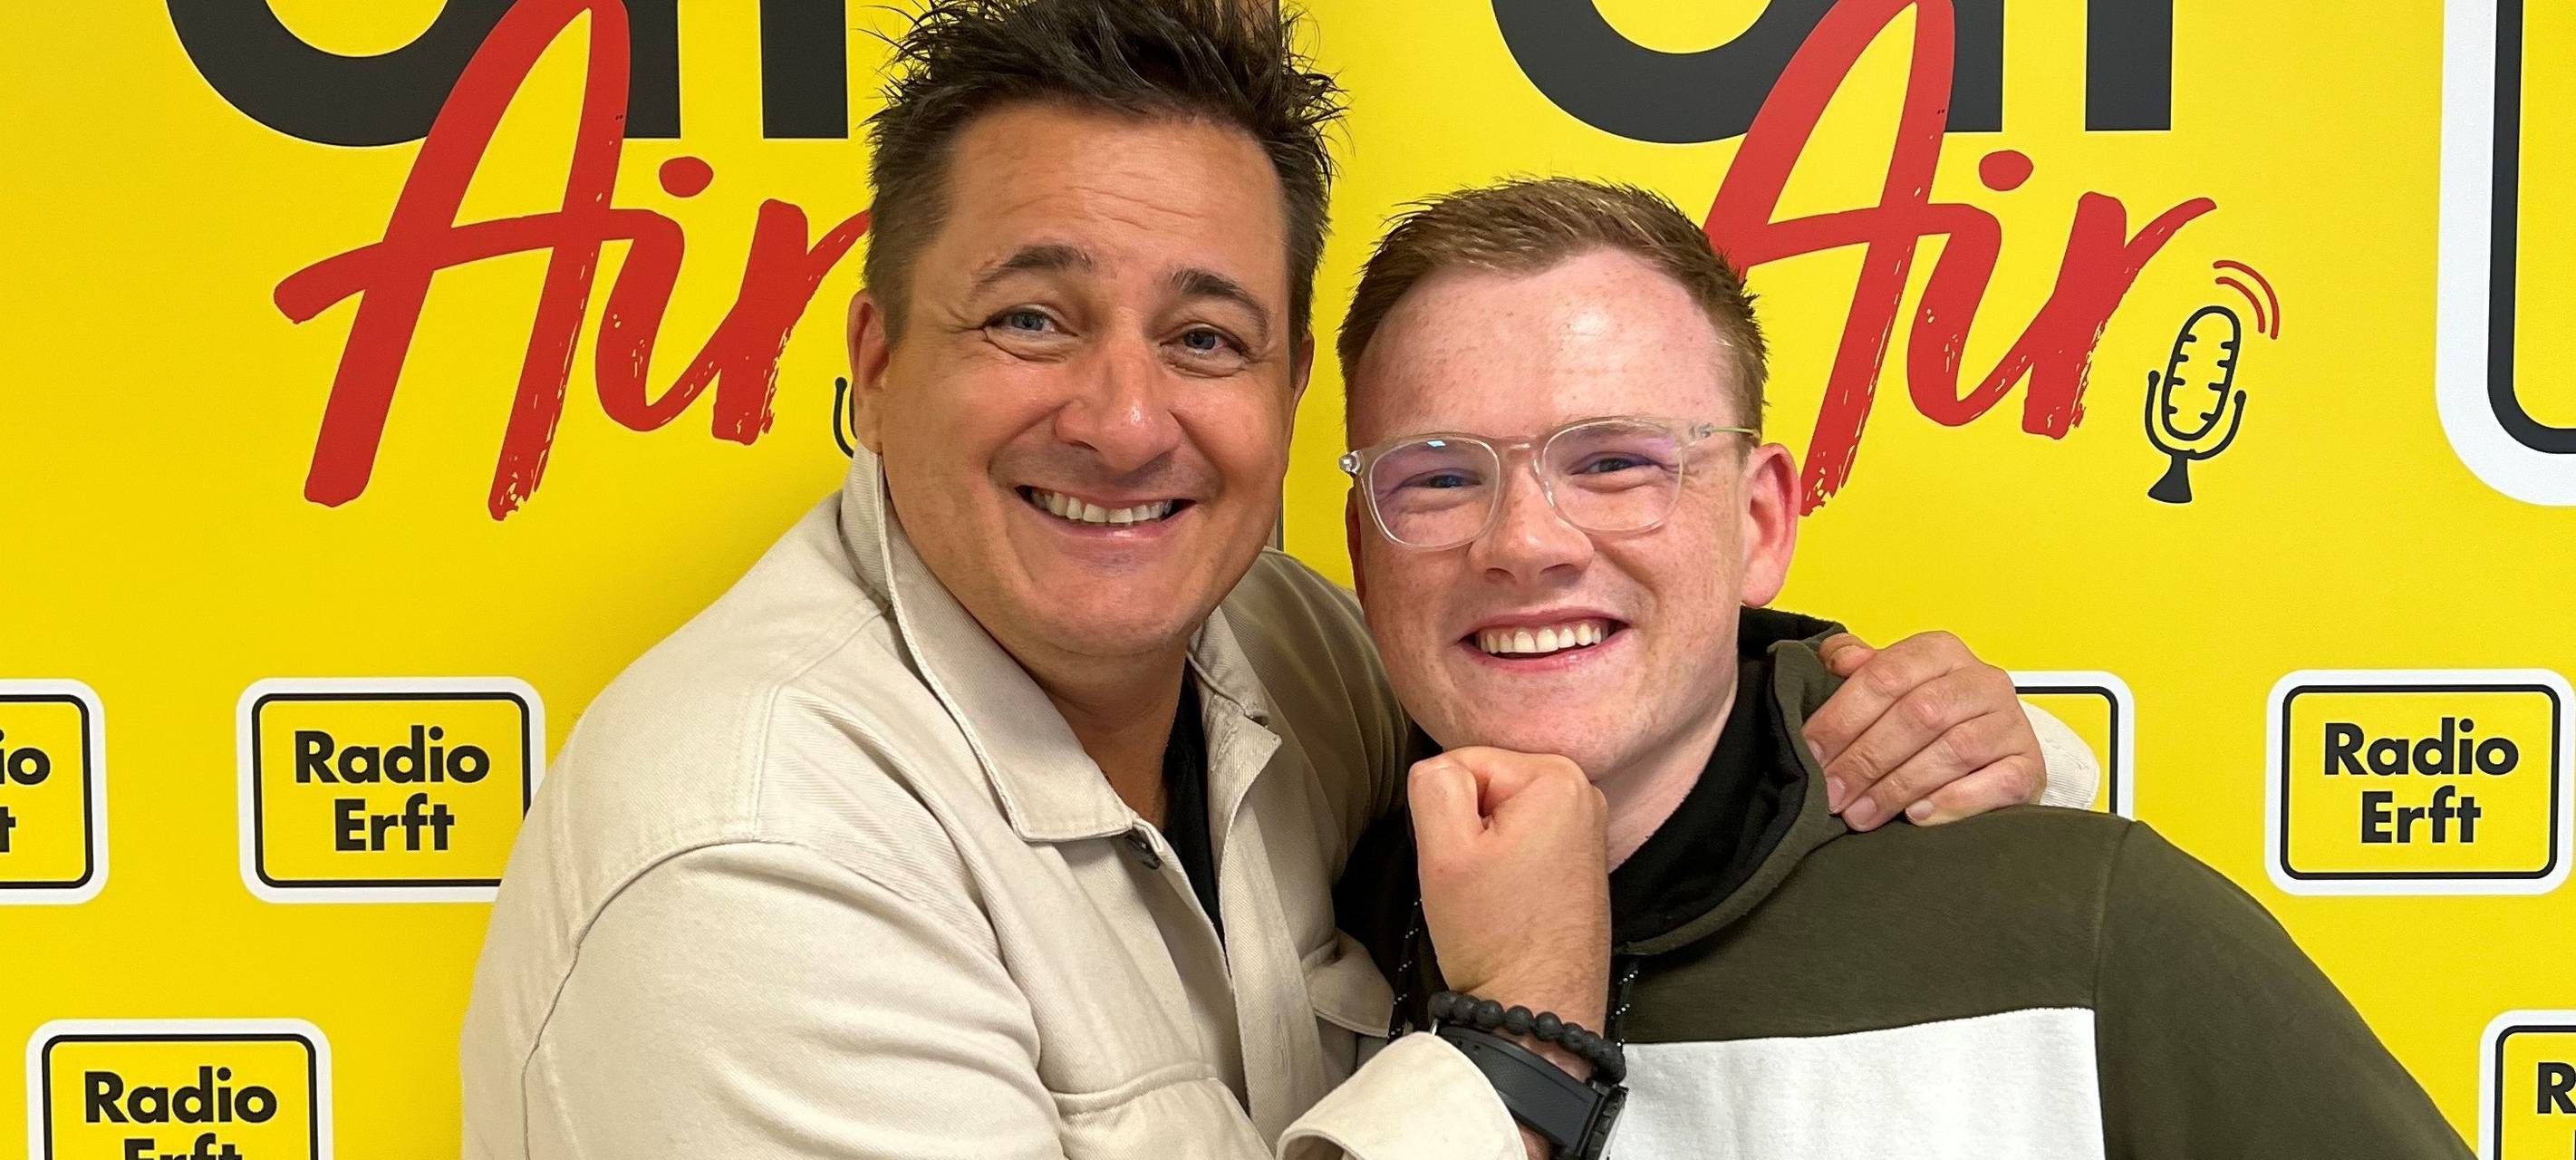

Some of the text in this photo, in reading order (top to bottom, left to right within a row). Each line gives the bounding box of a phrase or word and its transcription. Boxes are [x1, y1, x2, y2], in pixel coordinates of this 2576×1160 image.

[274, 0, 870, 522] Air
[1703, 0, 2217, 517] Air
[294, 724, 490, 784] Radio
[2324, 717, 2519, 777] Radio
[334, 792, 455, 852] Erft
[2361, 785, 2482, 844] Erft
[84, 1066, 277, 1124] Radio
